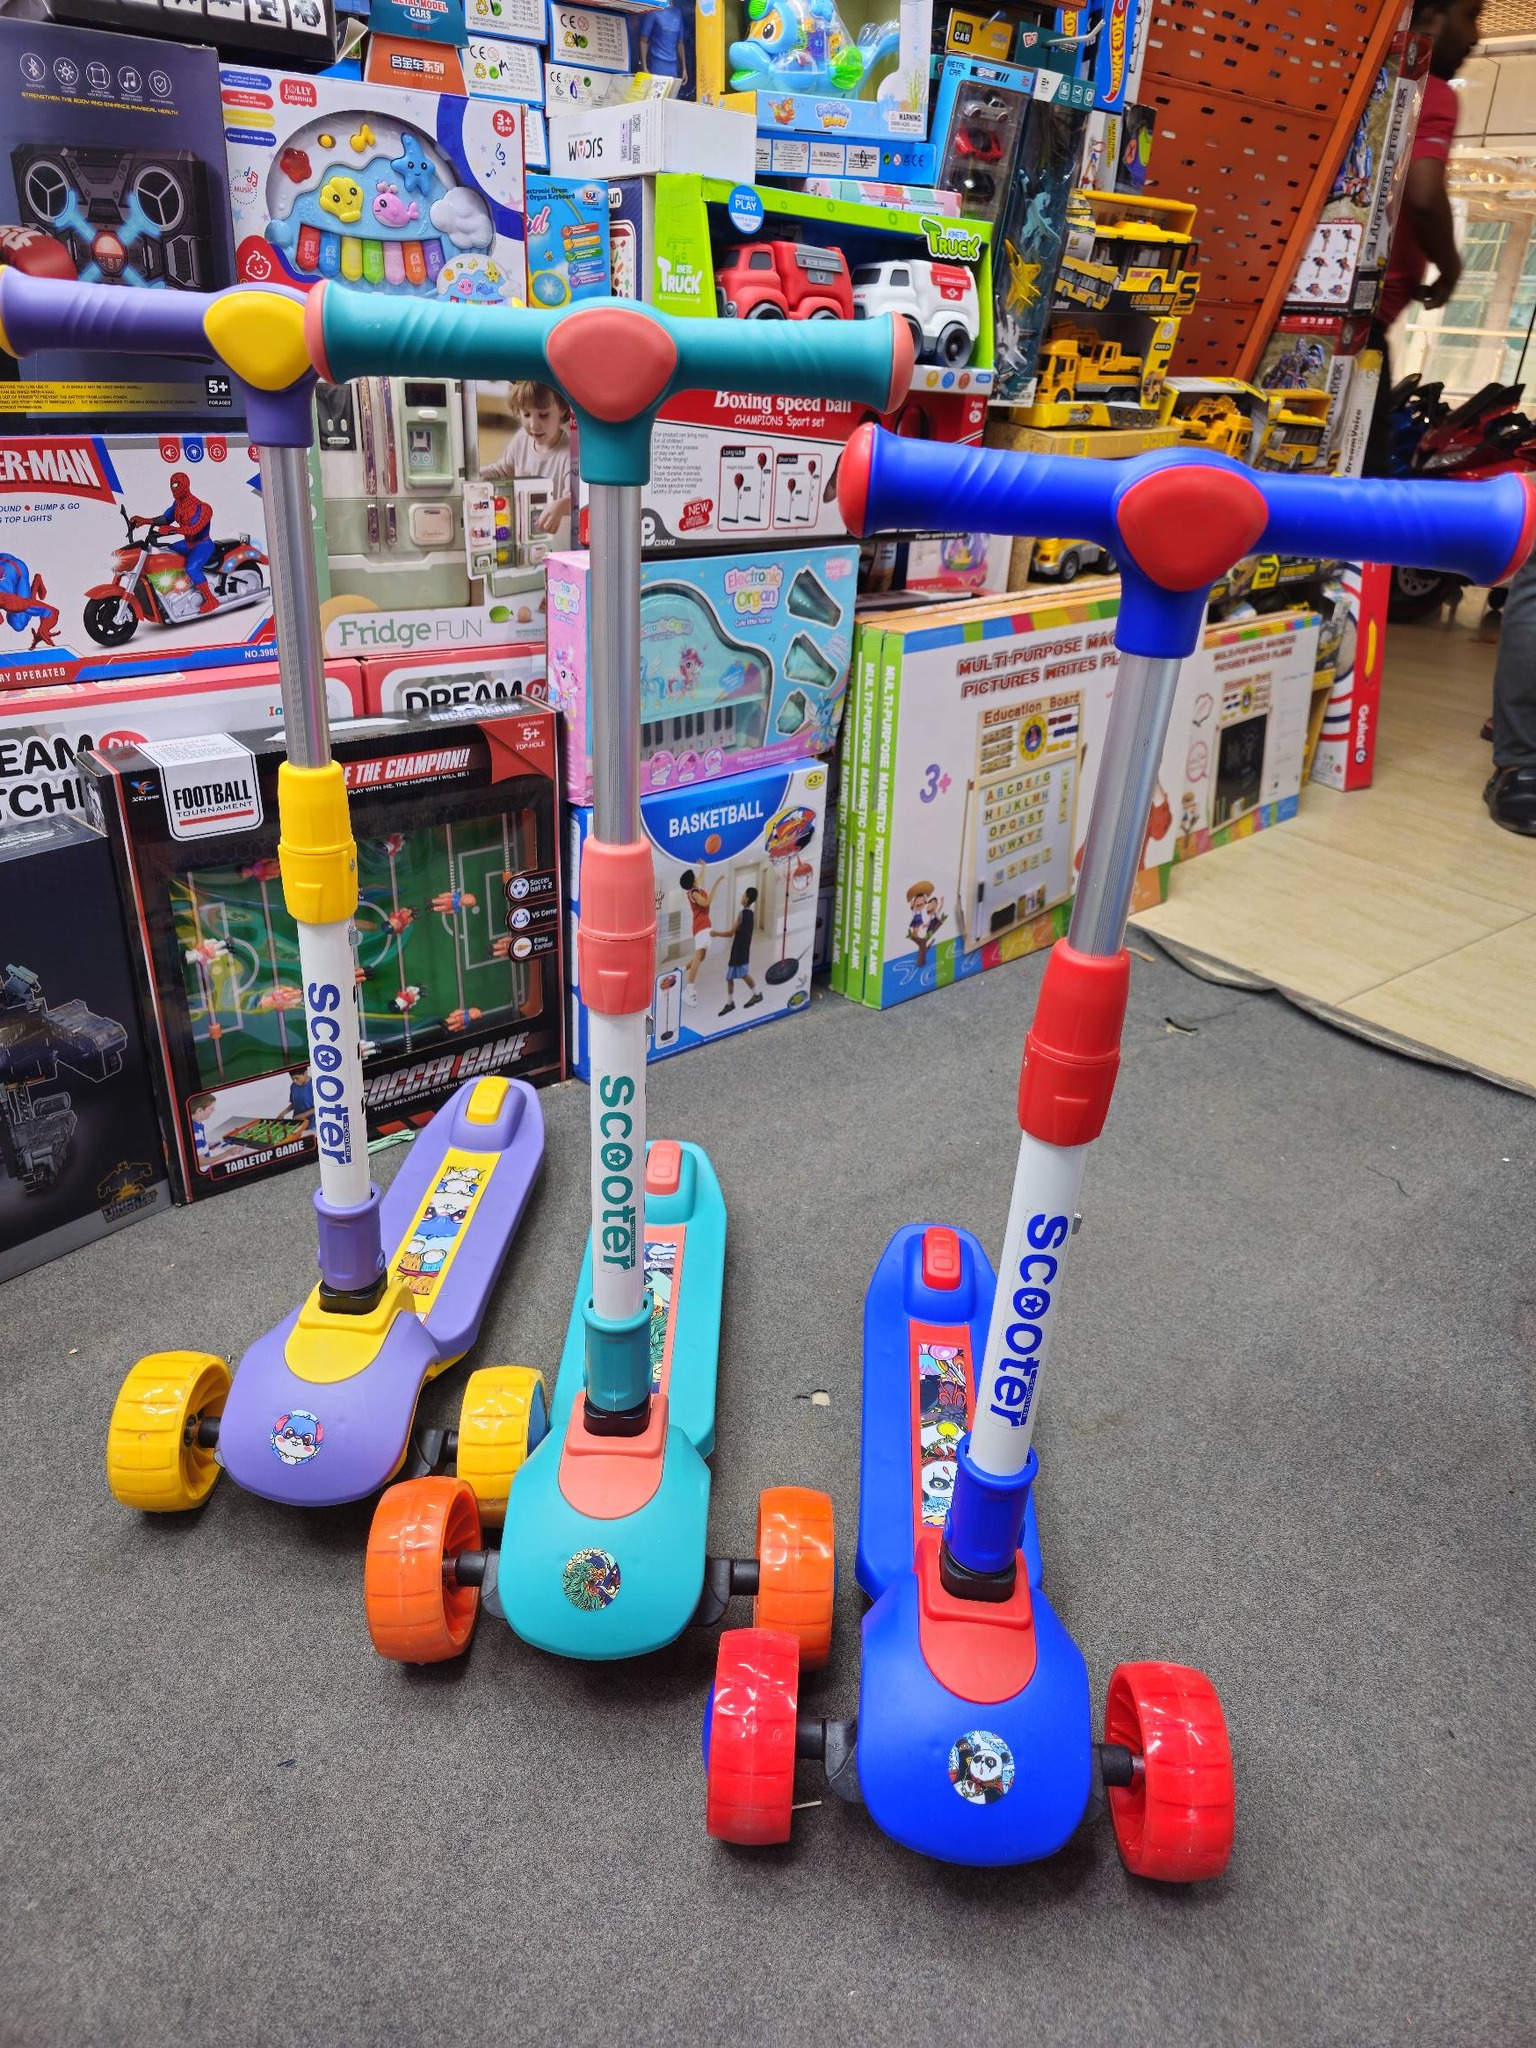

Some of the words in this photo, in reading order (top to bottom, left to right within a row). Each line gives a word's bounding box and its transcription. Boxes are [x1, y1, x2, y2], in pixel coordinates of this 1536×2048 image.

[410, 8, 431, 19] CARS
[954, 32, 970, 42] CAR
[285, 84, 312, 95] JOLLY
[497, 114, 511, 125] 3+
[735, 200, 757, 211] PLAY
[921, 219, 980, 259] TRUCK
[657, 256, 703, 295] TRUCK
[208, 379, 228, 394] 5+
[714, 391, 772, 415] Boxing
[776, 394, 821, 414] speed
[734, 414, 783, 427] CHAMPIONS
[786, 415, 810, 429] Sport
[811, 417, 825, 427] set
[34, 503, 58, 511] BUMP
[60, 503, 65, 511] &
[67, 502, 80, 510] GO
[688, 501, 710, 516] NEW
[4, 516, 21, 524] TOP
[23, 514, 52, 523] LIGHTS
[727, 571, 782, 588] Electronic
[737, 589, 775, 608] Organ
[339, 619, 431, 648] Fridge
[437, 619, 482, 640] FUN
[958, 637, 1083, 676] MULTI-PURPOSE
[16, 667, 66, 681] OPERATED
[962, 670, 1040, 699] PICTURES
[1044, 656, 1097, 680] WRITES
[861, 662, 875, 764] MULTI-PURPOSE
[880, 665, 896, 770] MULTI-PURPOSE
[984, 702, 1042, 725] Education
[1050, 694, 1080, 709] Board
[523, 728, 540, 741] 5+
[515, 740, 546, 750] TOP-HOLE
[356, 762, 381, 783] THE
[385, 748, 471, 780] CHAMPION!!
[348, 787, 364, 796] PLAY
[365, 785, 382, 793] WITH
[395, 780, 409, 788] THE
[920, 764, 952, 804] 3+
[173, 779, 252, 811] FOOTBALL
[176, 801, 253, 818] TOURNAMENT
[669, 800, 764, 838] BASKETBALL
[873, 837, 885, 894] PICTURES
[530, 877, 550, 887] Soccer
[530, 884, 541, 893] ball
[541, 908, 557, 917] Game
[534, 936, 548, 944] Easy
[534, 941, 553, 951] Control
[362, 1054, 457, 1107] SOCCER
[459, 1031, 530, 1077] GAME
[374, 1102, 393, 1112] THAT
[394, 1091, 431, 1106] BELONGS
[432, 1087, 441, 1095] TO
[443, 1081, 457, 1091] YOU
[224, 1149, 274, 1176] TABLETOP
[276, 1139, 305, 1158] GAME
